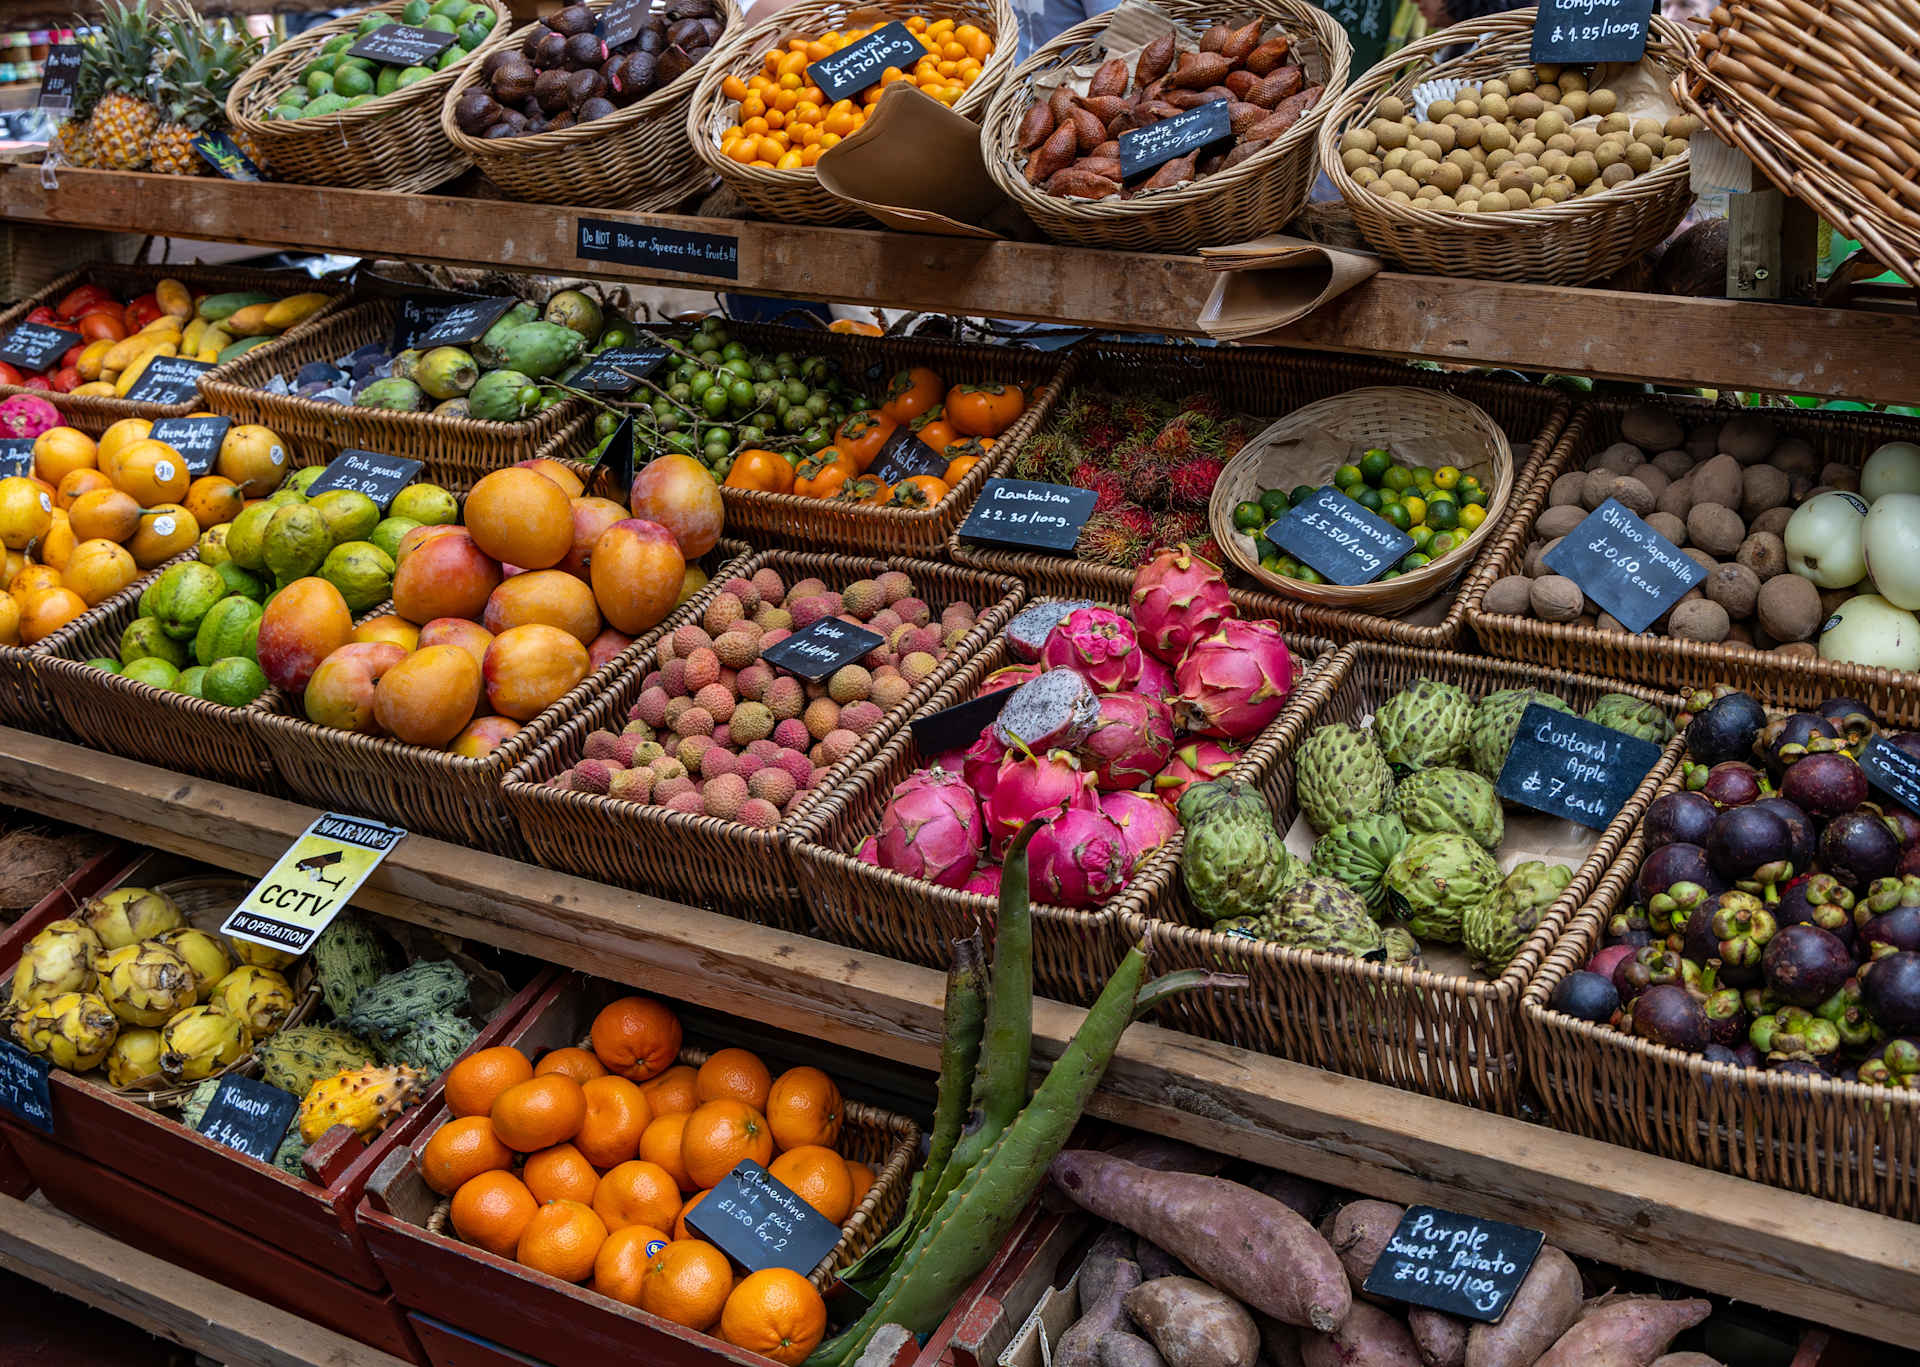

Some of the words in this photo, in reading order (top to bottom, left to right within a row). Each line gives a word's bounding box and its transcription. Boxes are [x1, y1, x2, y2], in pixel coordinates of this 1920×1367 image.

[820, 34, 886, 76] Kumquat
[582, 227, 593, 245] Do
[595, 230, 611, 245] NOT
[638, 239, 648, 248] or
[649, 236, 684, 256] Squeeze
[687, 242, 702, 256] the
[344, 456, 370, 471] Pink
[994, 487, 1070, 504] Rambutan
[1319, 496, 1402, 550] Calamansi
[1301, 513, 1381, 572] £5.50/100g
[1602, 507, 1643, 543] Chikoo
[1643, 535, 1693, 585] Sapodilla
[1588, 537, 1640, 573] £0.60
[1631, 575, 1661, 598] each
[1536, 721, 1607, 761] Custard
[1567, 757, 1606, 782] Apple
[1565, 794, 1605, 816] each
[317, 818, 394, 848] WARNING
[260, 884, 334, 917] CCTV
[233, 915, 246, 927] IN
[249, 919, 308, 945] OPERATION
[222, 1086, 270, 1117] Kiwano
[743, 1170, 806, 1221] Clementine
[718, 1199, 753, 1226] £1.50
[755, 1222, 774, 1242] for
[774, 1238, 788, 1252] 2
[769, 1211, 793, 1235] each
[1411, 1214, 1489, 1252] Purple
[1387, 1236, 1438, 1260] Sweet
[1394, 1262, 1501, 1312] £0.70/100g
